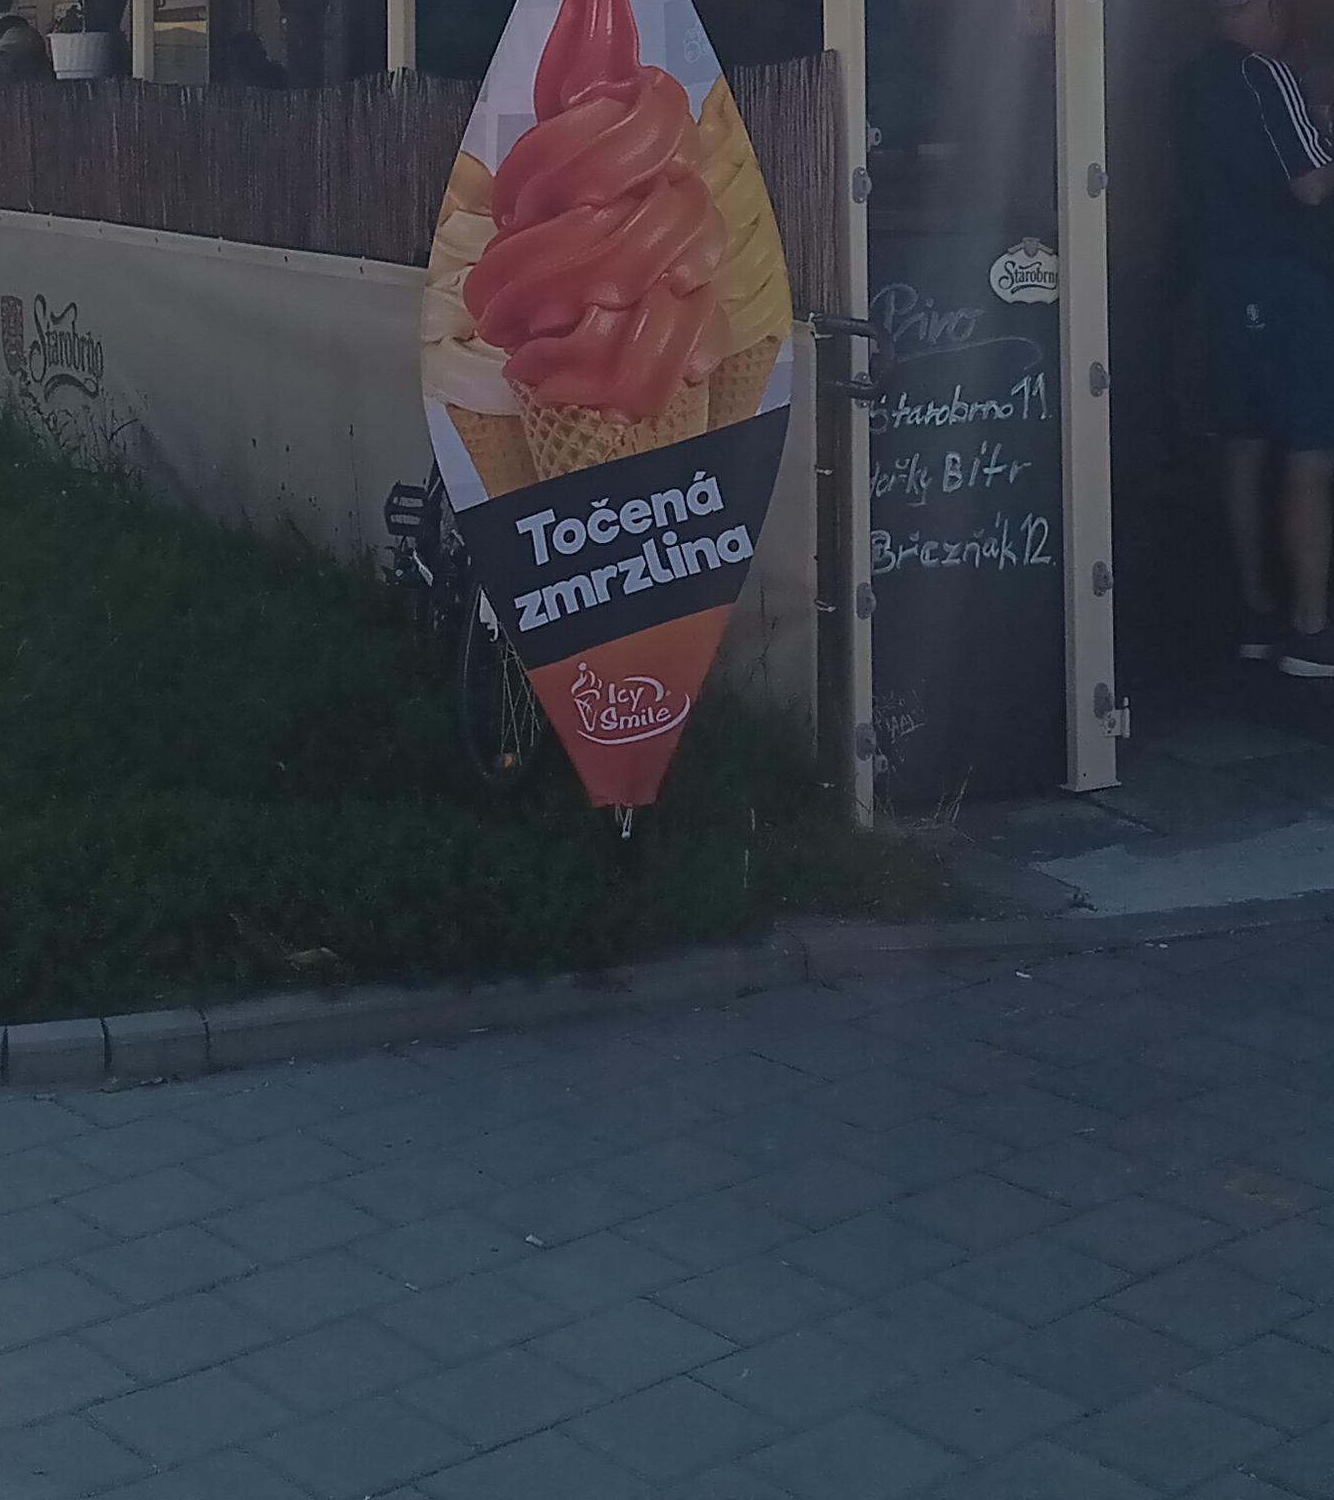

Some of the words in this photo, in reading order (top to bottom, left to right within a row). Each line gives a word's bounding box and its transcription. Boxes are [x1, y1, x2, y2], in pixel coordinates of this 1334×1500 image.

[998, 260, 1058, 295] Starobrn
[516, 471, 725, 566] Točená
[514, 524, 754, 633] zmrzlina
[608, 682, 644, 710] Icy
[599, 702, 672, 731] Smile
